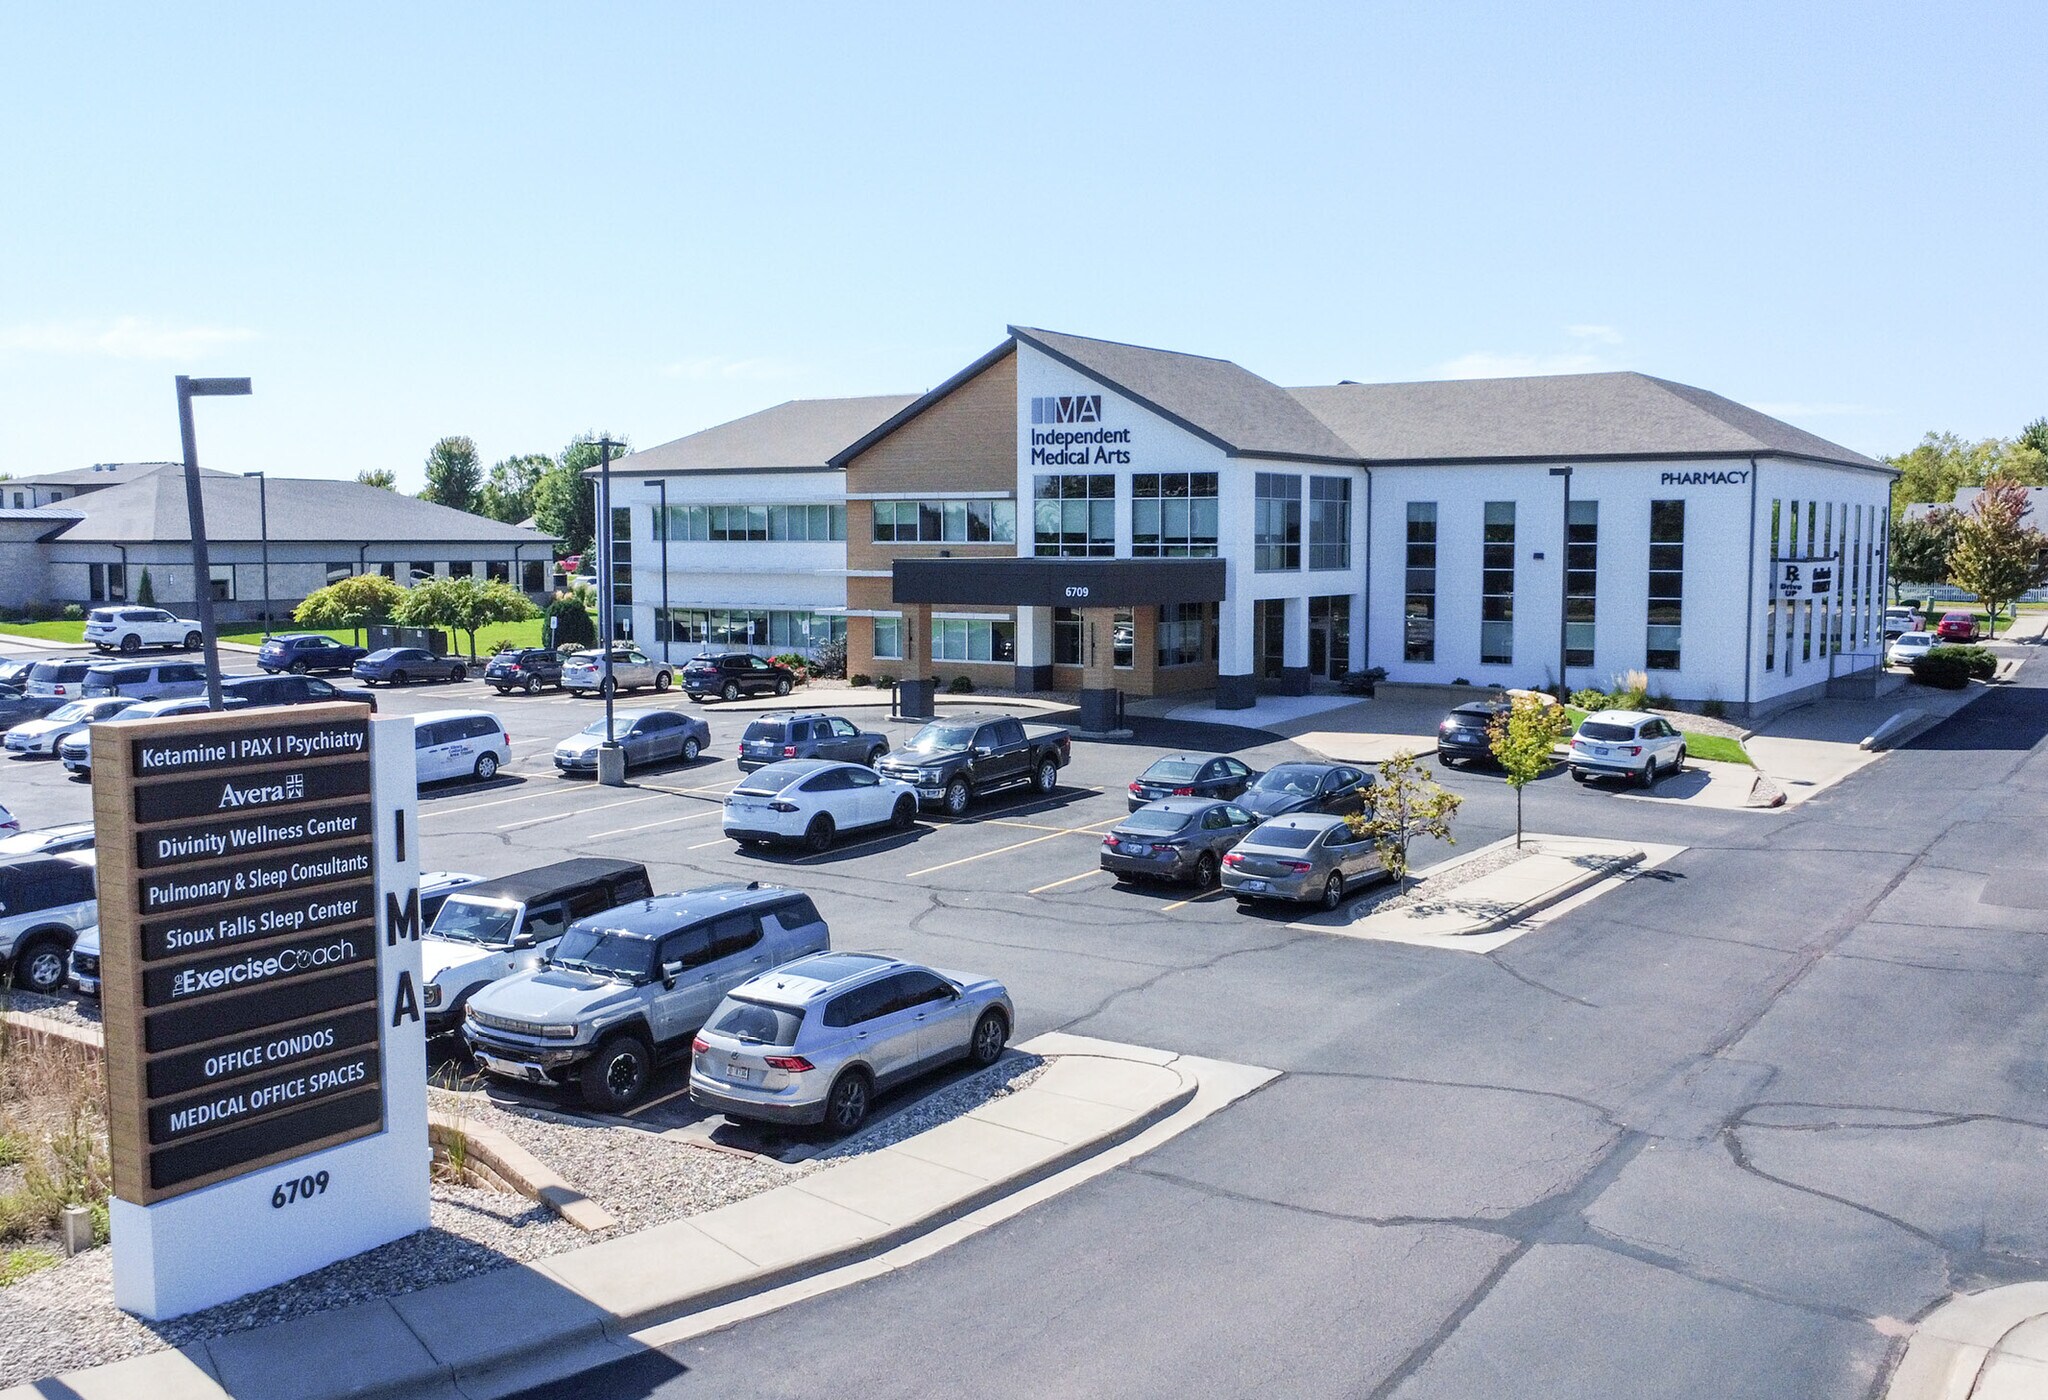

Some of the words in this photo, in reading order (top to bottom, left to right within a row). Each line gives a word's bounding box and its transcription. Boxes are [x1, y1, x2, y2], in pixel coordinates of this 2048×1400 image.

[1031, 447, 1089, 465] Medical
[1094, 446, 1130, 464] Arts
[1032, 428, 1130, 451] Independent
[1661, 471, 1750, 485] PHARMACY
[1065, 586, 1089, 597] 6709
[142, 743, 226, 768] Ketamine
[241, 737, 273, 757] PAX
[286, 730, 364, 756] Psychiatry
[218, 783, 285, 808] Avera
[159, 833, 227, 858] Divinity
[230, 826, 303, 847] Wellness
[307, 815, 357, 836] Center
[149, 878, 231, 906] Pulmonary
[235, 872, 245, 890] &
[249, 862, 288, 889] Sleep
[291, 854, 368, 880] Consultants
[166, 927, 214, 950] Sioux
[219, 917, 255, 938] Falls
[261, 908, 304, 931] Sleep
[308, 898, 358, 920] Center
[204, 1047, 262, 1077] OFFICE
[267, 1028, 334, 1060] CONDOS
[171, 1095, 248, 1132] MEDICAL
[251, 1080, 306, 1109] OFFICE
[309, 1062, 365, 1094] SPACES
[271, 1170, 330, 1210] 6709
